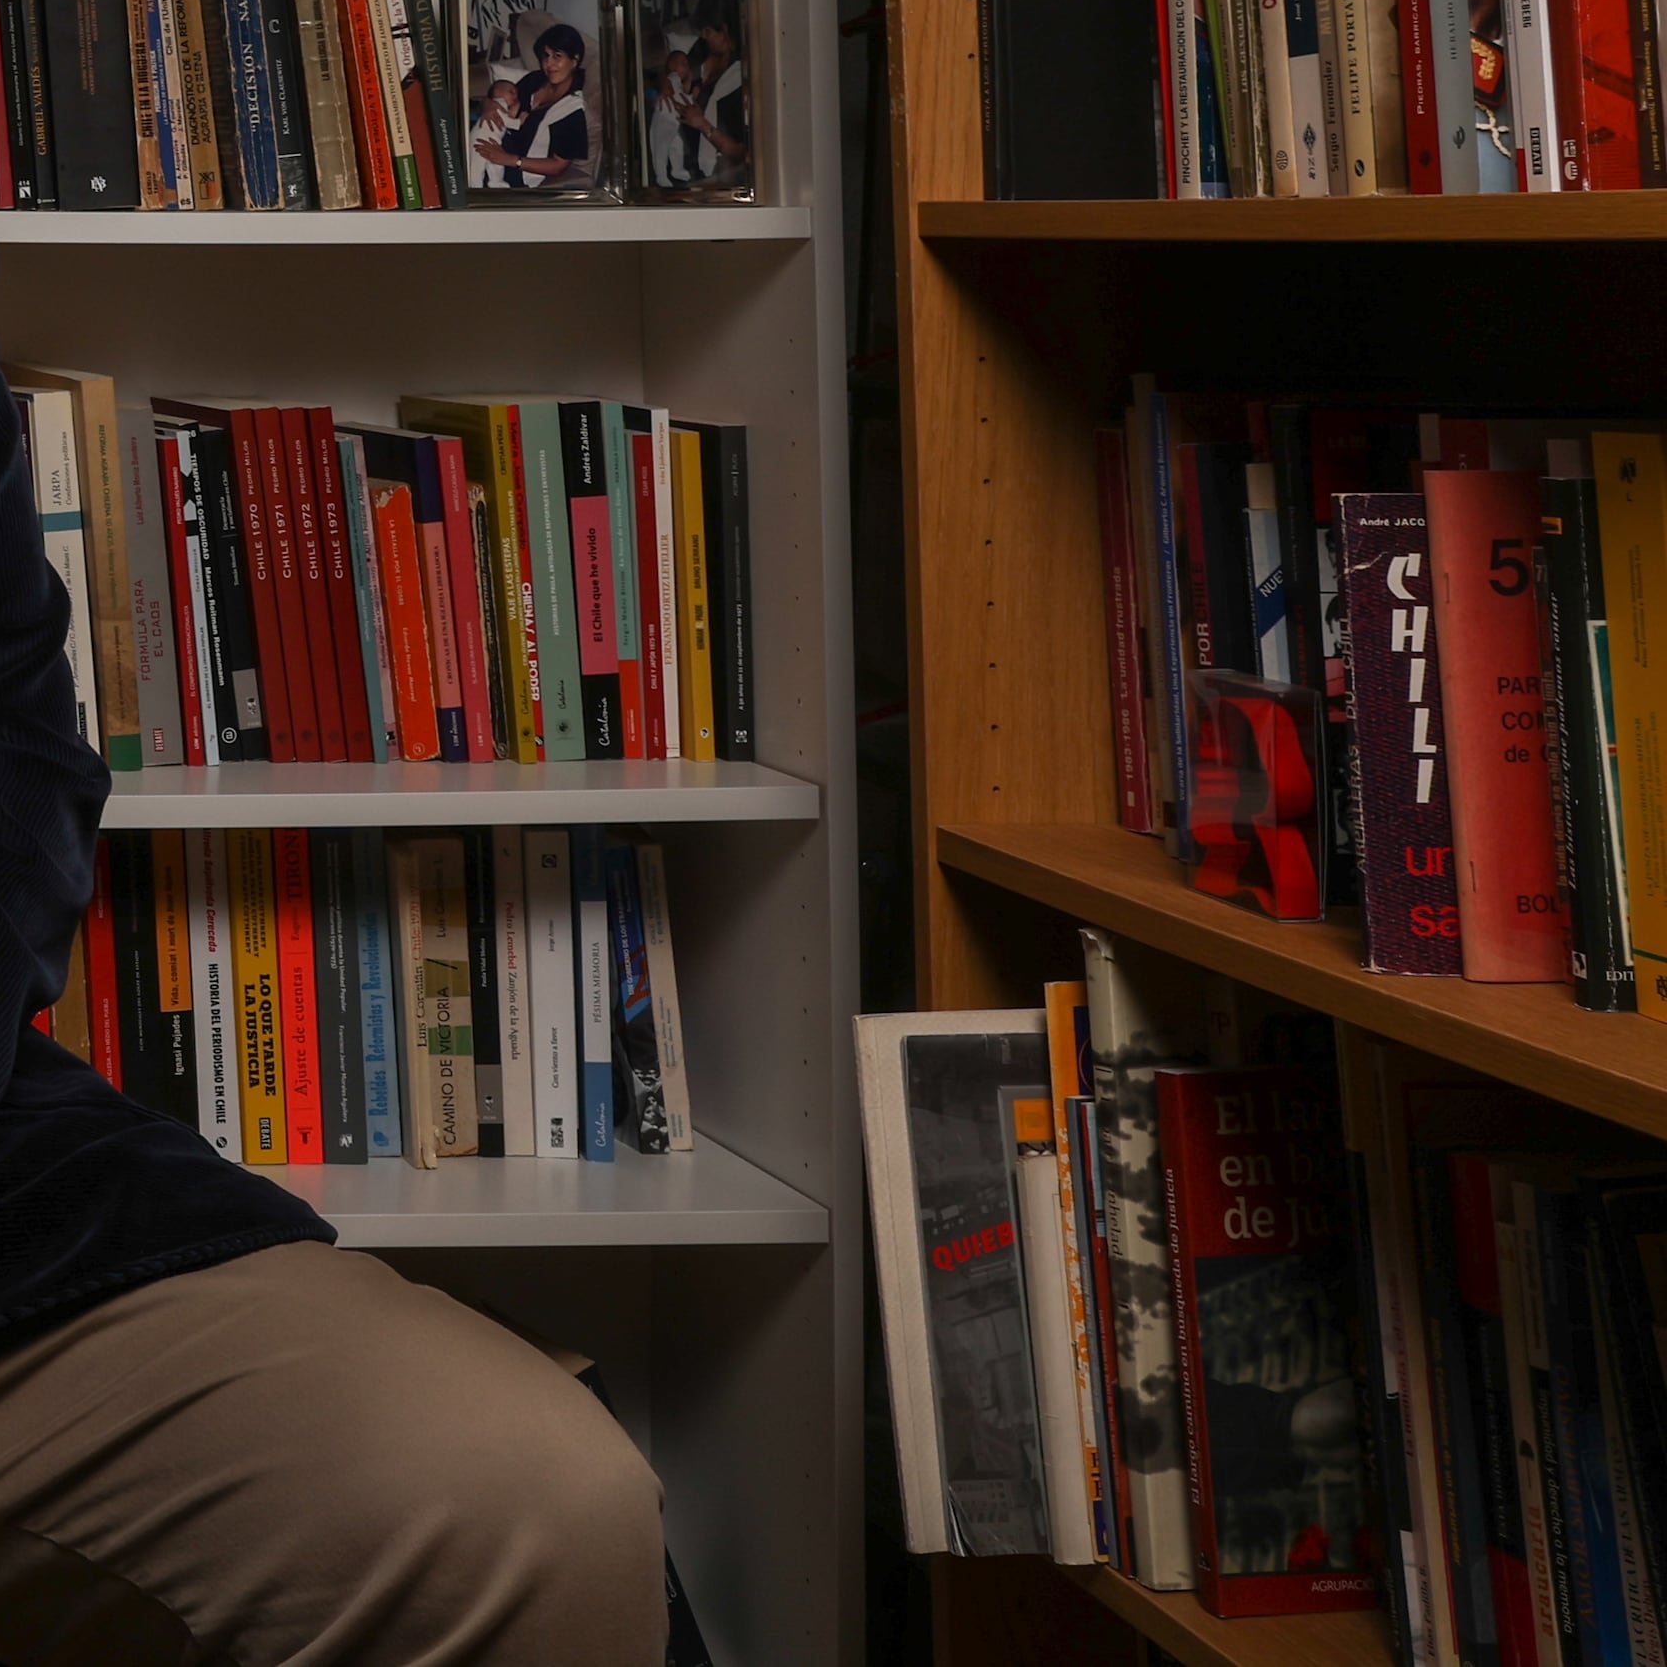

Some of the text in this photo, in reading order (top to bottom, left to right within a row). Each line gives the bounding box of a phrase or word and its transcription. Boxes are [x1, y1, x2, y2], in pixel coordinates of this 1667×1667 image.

[249, 503, 266, 580] CHILE 1970
[274, 504, 291, 578] CHILE 1971
[301, 503, 318, 579] CHILE 1972
[326, 502, 343, 579] CHILE 1973
[1489, 539, 1529, 596] 5
[586, 527, 603, 642] El Chile que he vivido
[1387, 553, 1437, 804] CHILI
[244, 984, 260, 1088] LA JUSTICIA
[259, 974, 276, 1096] LO QUE TARDE
[1217, 1092, 1258, 1135] El
[1219, 1153, 1276, 1187] en
[1223, 1196, 1276, 1240] de
